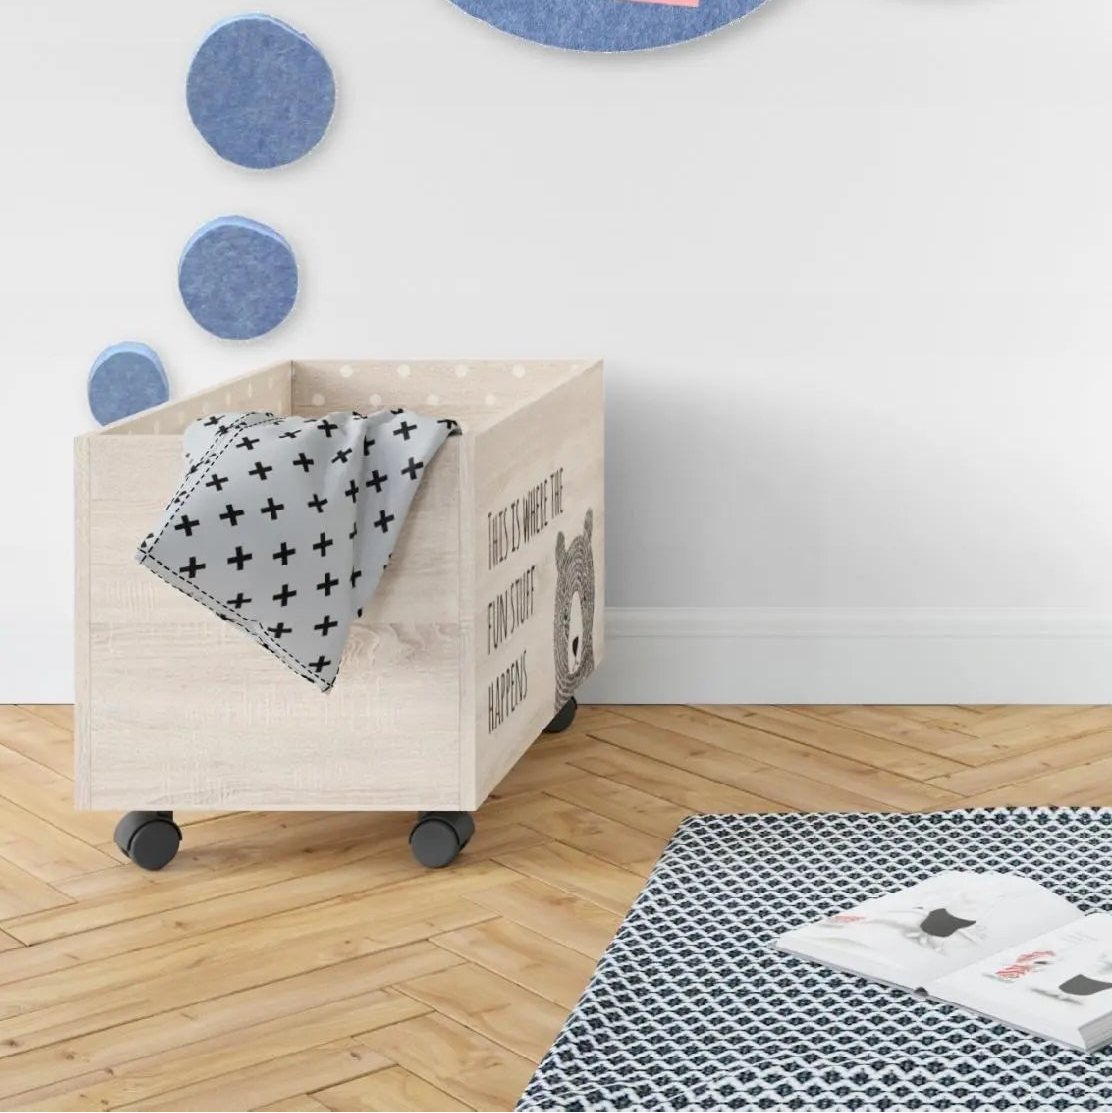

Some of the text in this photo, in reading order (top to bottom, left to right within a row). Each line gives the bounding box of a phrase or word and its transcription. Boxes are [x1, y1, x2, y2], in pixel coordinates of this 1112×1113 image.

[550, 467, 563, 519] THE
[488, 565, 535, 655] FUN STUFF
[488, 649, 527, 734] HAPPENS
